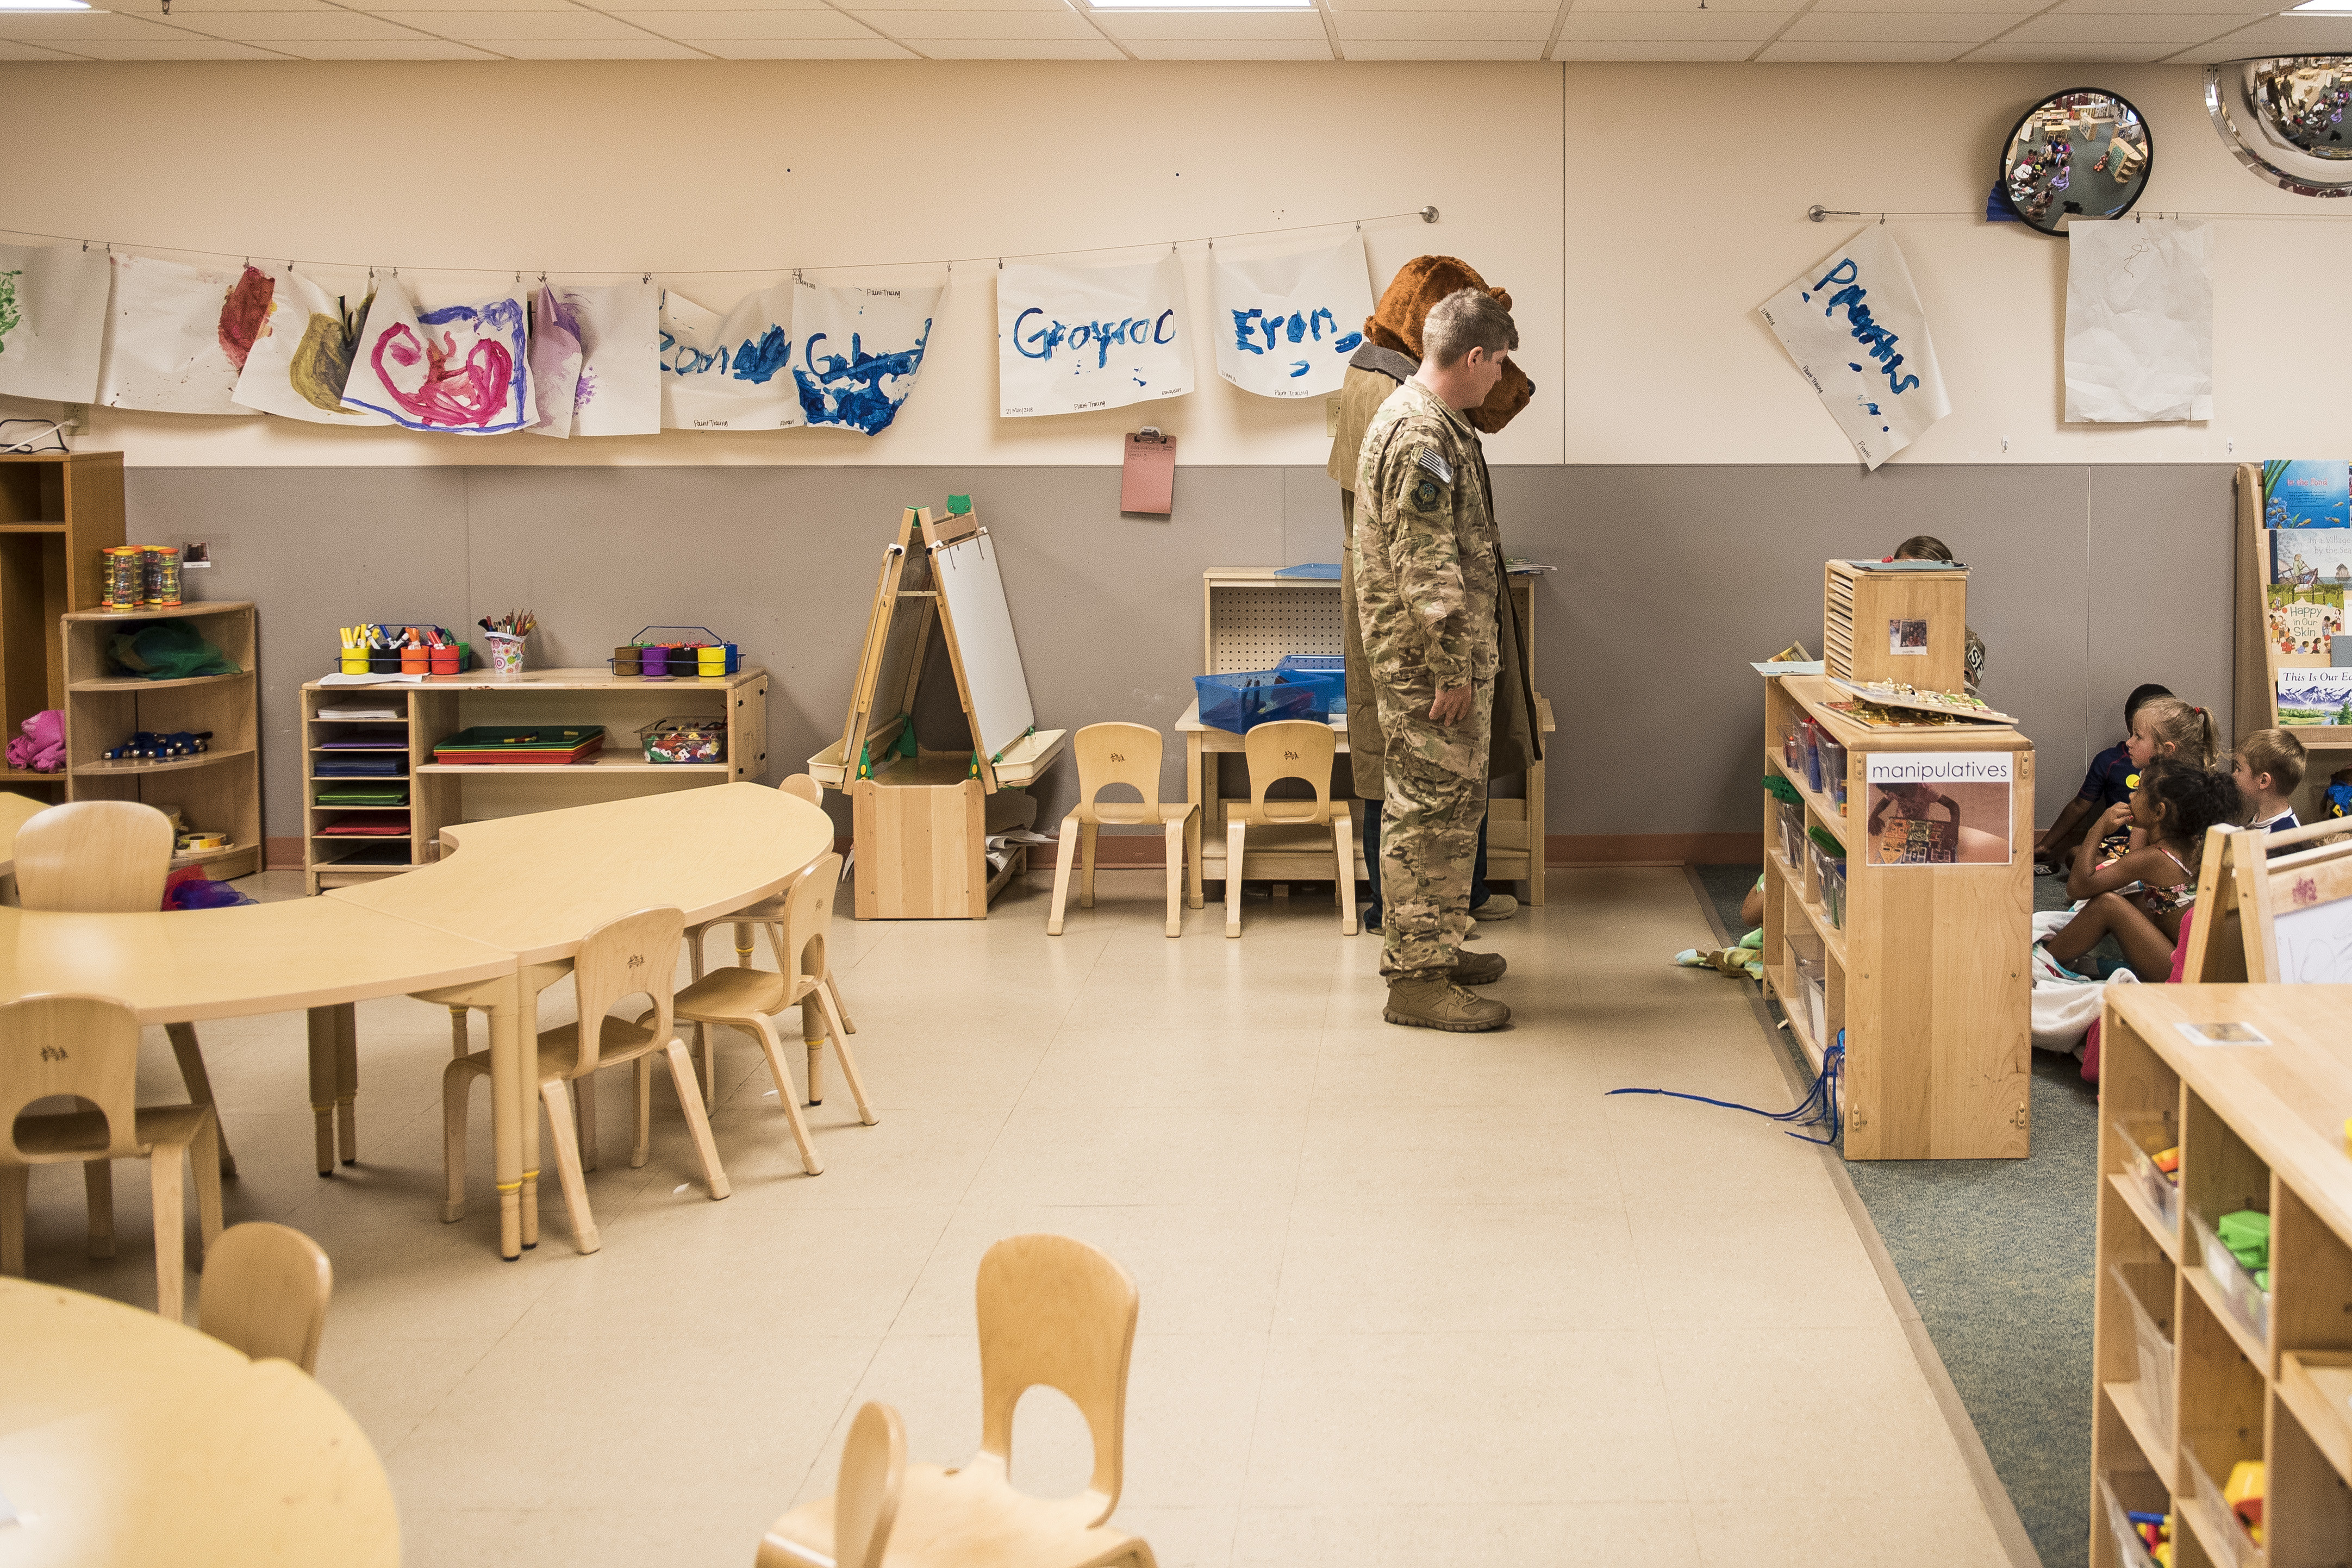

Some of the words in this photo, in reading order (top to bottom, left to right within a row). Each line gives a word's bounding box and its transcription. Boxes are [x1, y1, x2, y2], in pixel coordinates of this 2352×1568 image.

[866, 288, 883, 296] Paint
[883, 289, 901, 298] Tracing
[1802, 365, 1813, 378] Paint
[1088, 400, 1106, 408] Tracing
[693, 419, 709, 427] Paint
[709, 419, 728, 427] Tracing
[2287, 478, 2294, 486] In
[2296, 478, 2309, 486] the
[2310, 477, 2328, 486] Pond
[2325, 535, 2351, 545] Village
[2314, 546, 2323, 556] by
[2326, 546, 2338, 554] the
[2339, 546, 2351, 554] Sea
[2290, 607, 2323, 618] Happy
[2293, 626, 2316, 636] Skin
[1968, 649, 1985, 673] SF
[2282, 672, 2305, 681] This
[2309, 672, 2317, 682] Is
[2320, 672, 2338, 681] Our
[1873, 761, 2007, 780] manipulatives
